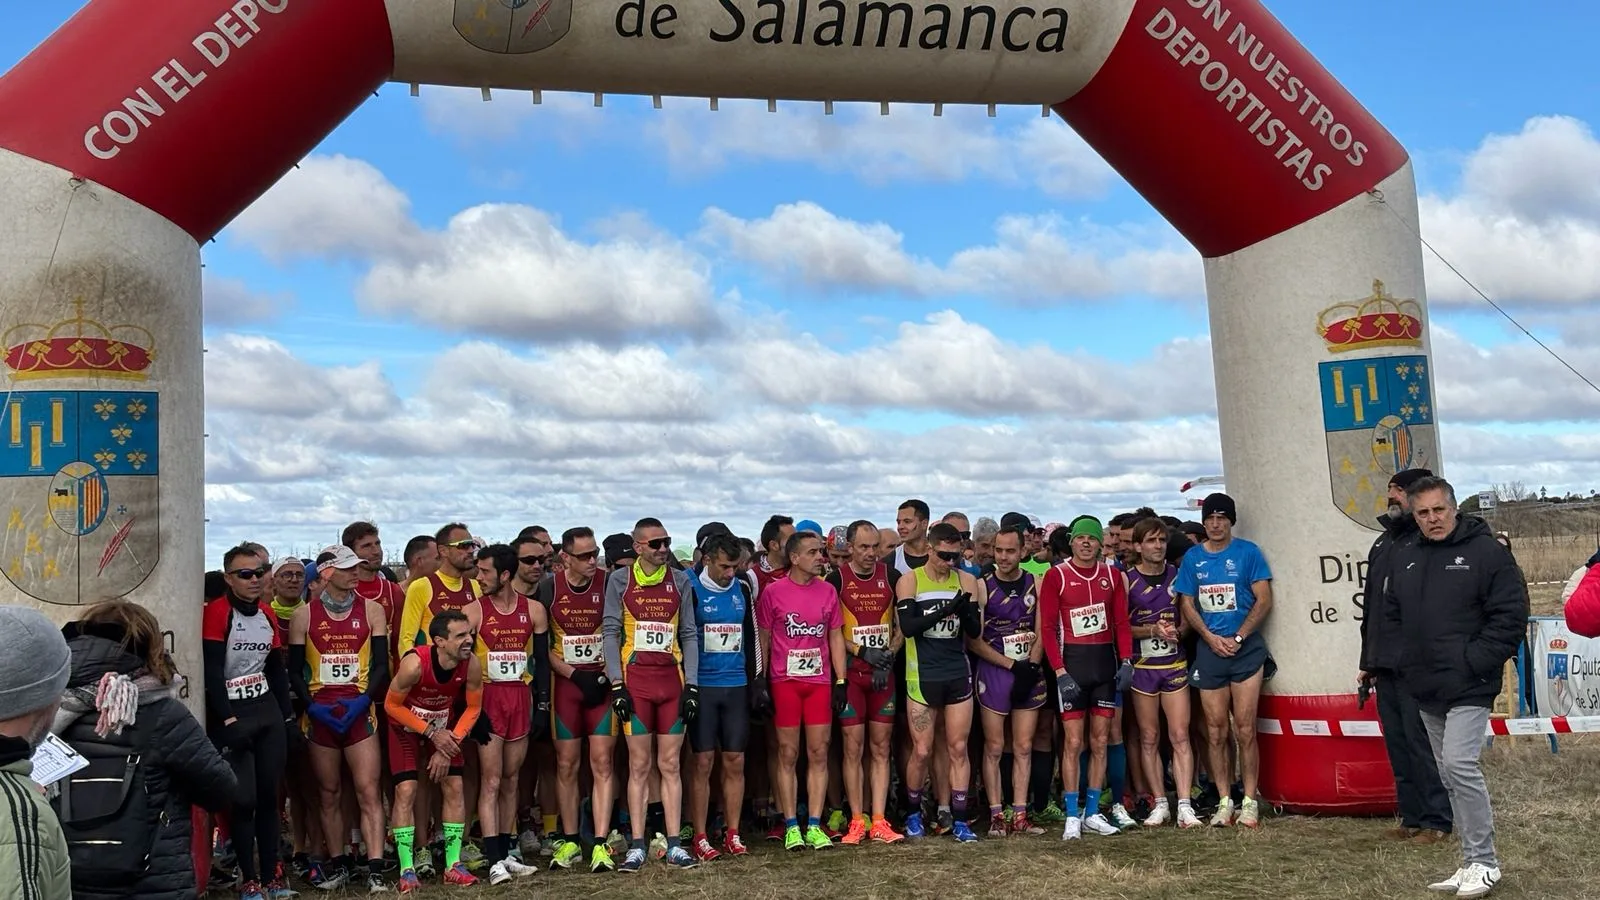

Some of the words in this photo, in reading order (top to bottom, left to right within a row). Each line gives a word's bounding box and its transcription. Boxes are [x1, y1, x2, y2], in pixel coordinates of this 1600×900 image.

[615, 0, 678, 39] de
[709, 0, 1068, 53] Salamanca
[1145, 7, 1333, 191] DEPORTISTAS
[1227, 22, 1369, 167] NUESTROS
[83, 87, 166, 161] CON
[151, 58, 208, 103] EL
[1208, 594, 1225, 606] 13
[1071, 605, 1105, 618] bedunia
[1310, 601, 1338, 624] de
[1082, 615, 1099, 628] 23
[705, 625, 741, 633] bedunia
[646, 632, 664, 644] 50
[720, 634, 729, 646] 7
[861, 635, 885, 647] 186
[1015, 642, 1029, 654] 30
[1151, 639, 1169, 651] 33
[575, 645, 593, 658] 56
[321, 655, 360, 664] bedunia
[798, 659, 814, 670] 24
[332, 664, 350, 677] 55
[500, 662, 516, 674] 51
[235, 684, 263, 699] 159
